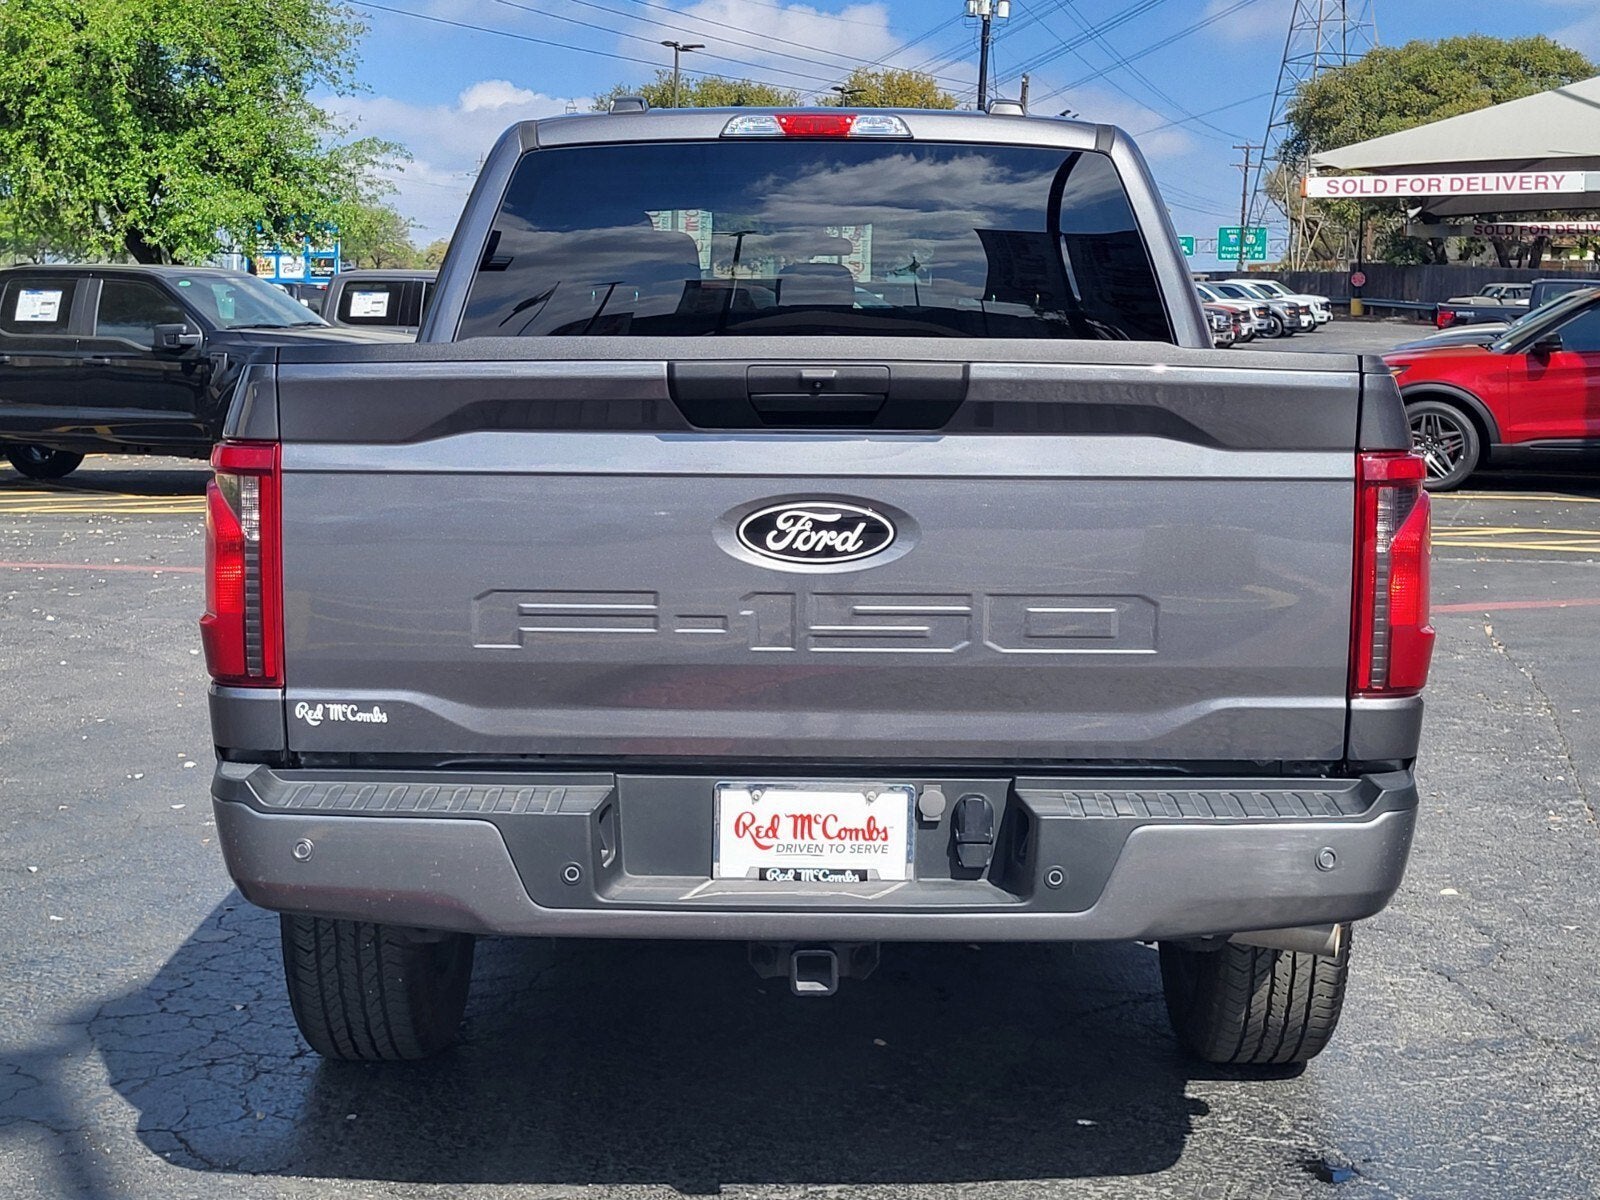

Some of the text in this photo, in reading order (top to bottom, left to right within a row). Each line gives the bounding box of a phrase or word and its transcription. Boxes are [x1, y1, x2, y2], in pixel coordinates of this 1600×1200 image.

[1326, 174, 1566, 195] SOLD FOR DELIVERY
[1473, 225, 1515, 236] SOLD
[1519, 225, 1551, 236] FOR
[765, 510, 867, 552] Ford
[471, 589, 1161, 654] F-150
[295, 701, 388, 726] Red McCombs
[734, 811, 889, 850] Red McCombs
[776, 844, 888, 854] DRIVEN TO SERVE
[766, 868, 860, 882] Red McCombs
